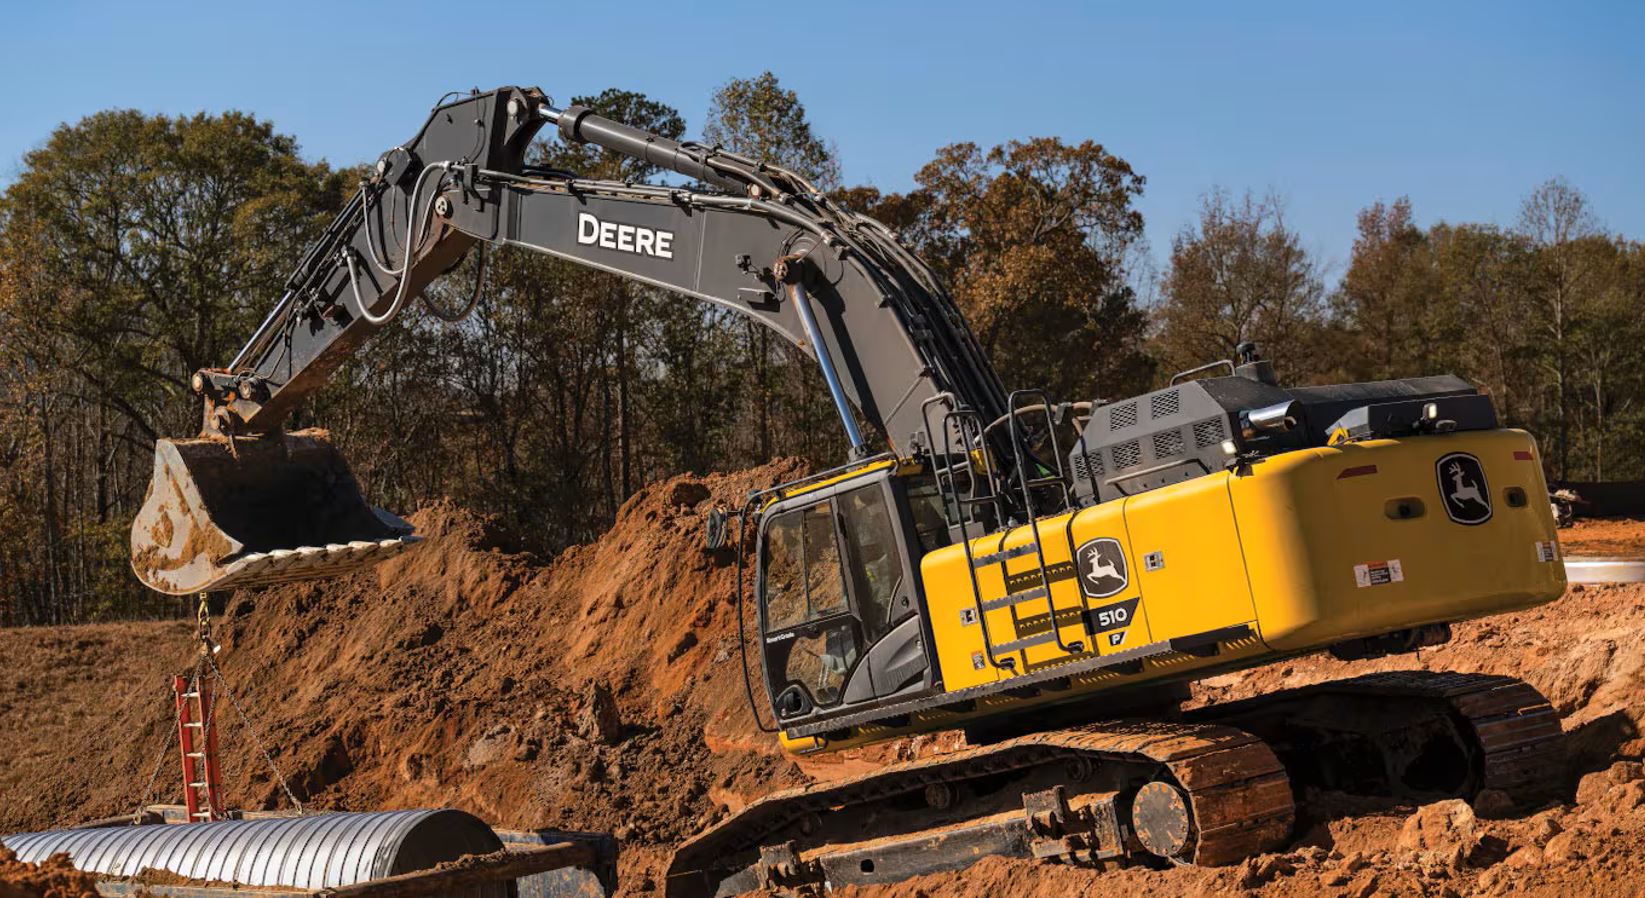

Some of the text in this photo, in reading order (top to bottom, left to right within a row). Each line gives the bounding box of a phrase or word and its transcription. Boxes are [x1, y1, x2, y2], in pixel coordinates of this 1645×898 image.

[578, 212, 674, 259] DEERE
[1098, 608, 1128, 627] 510
[1111, 634, 1121, 645] P
